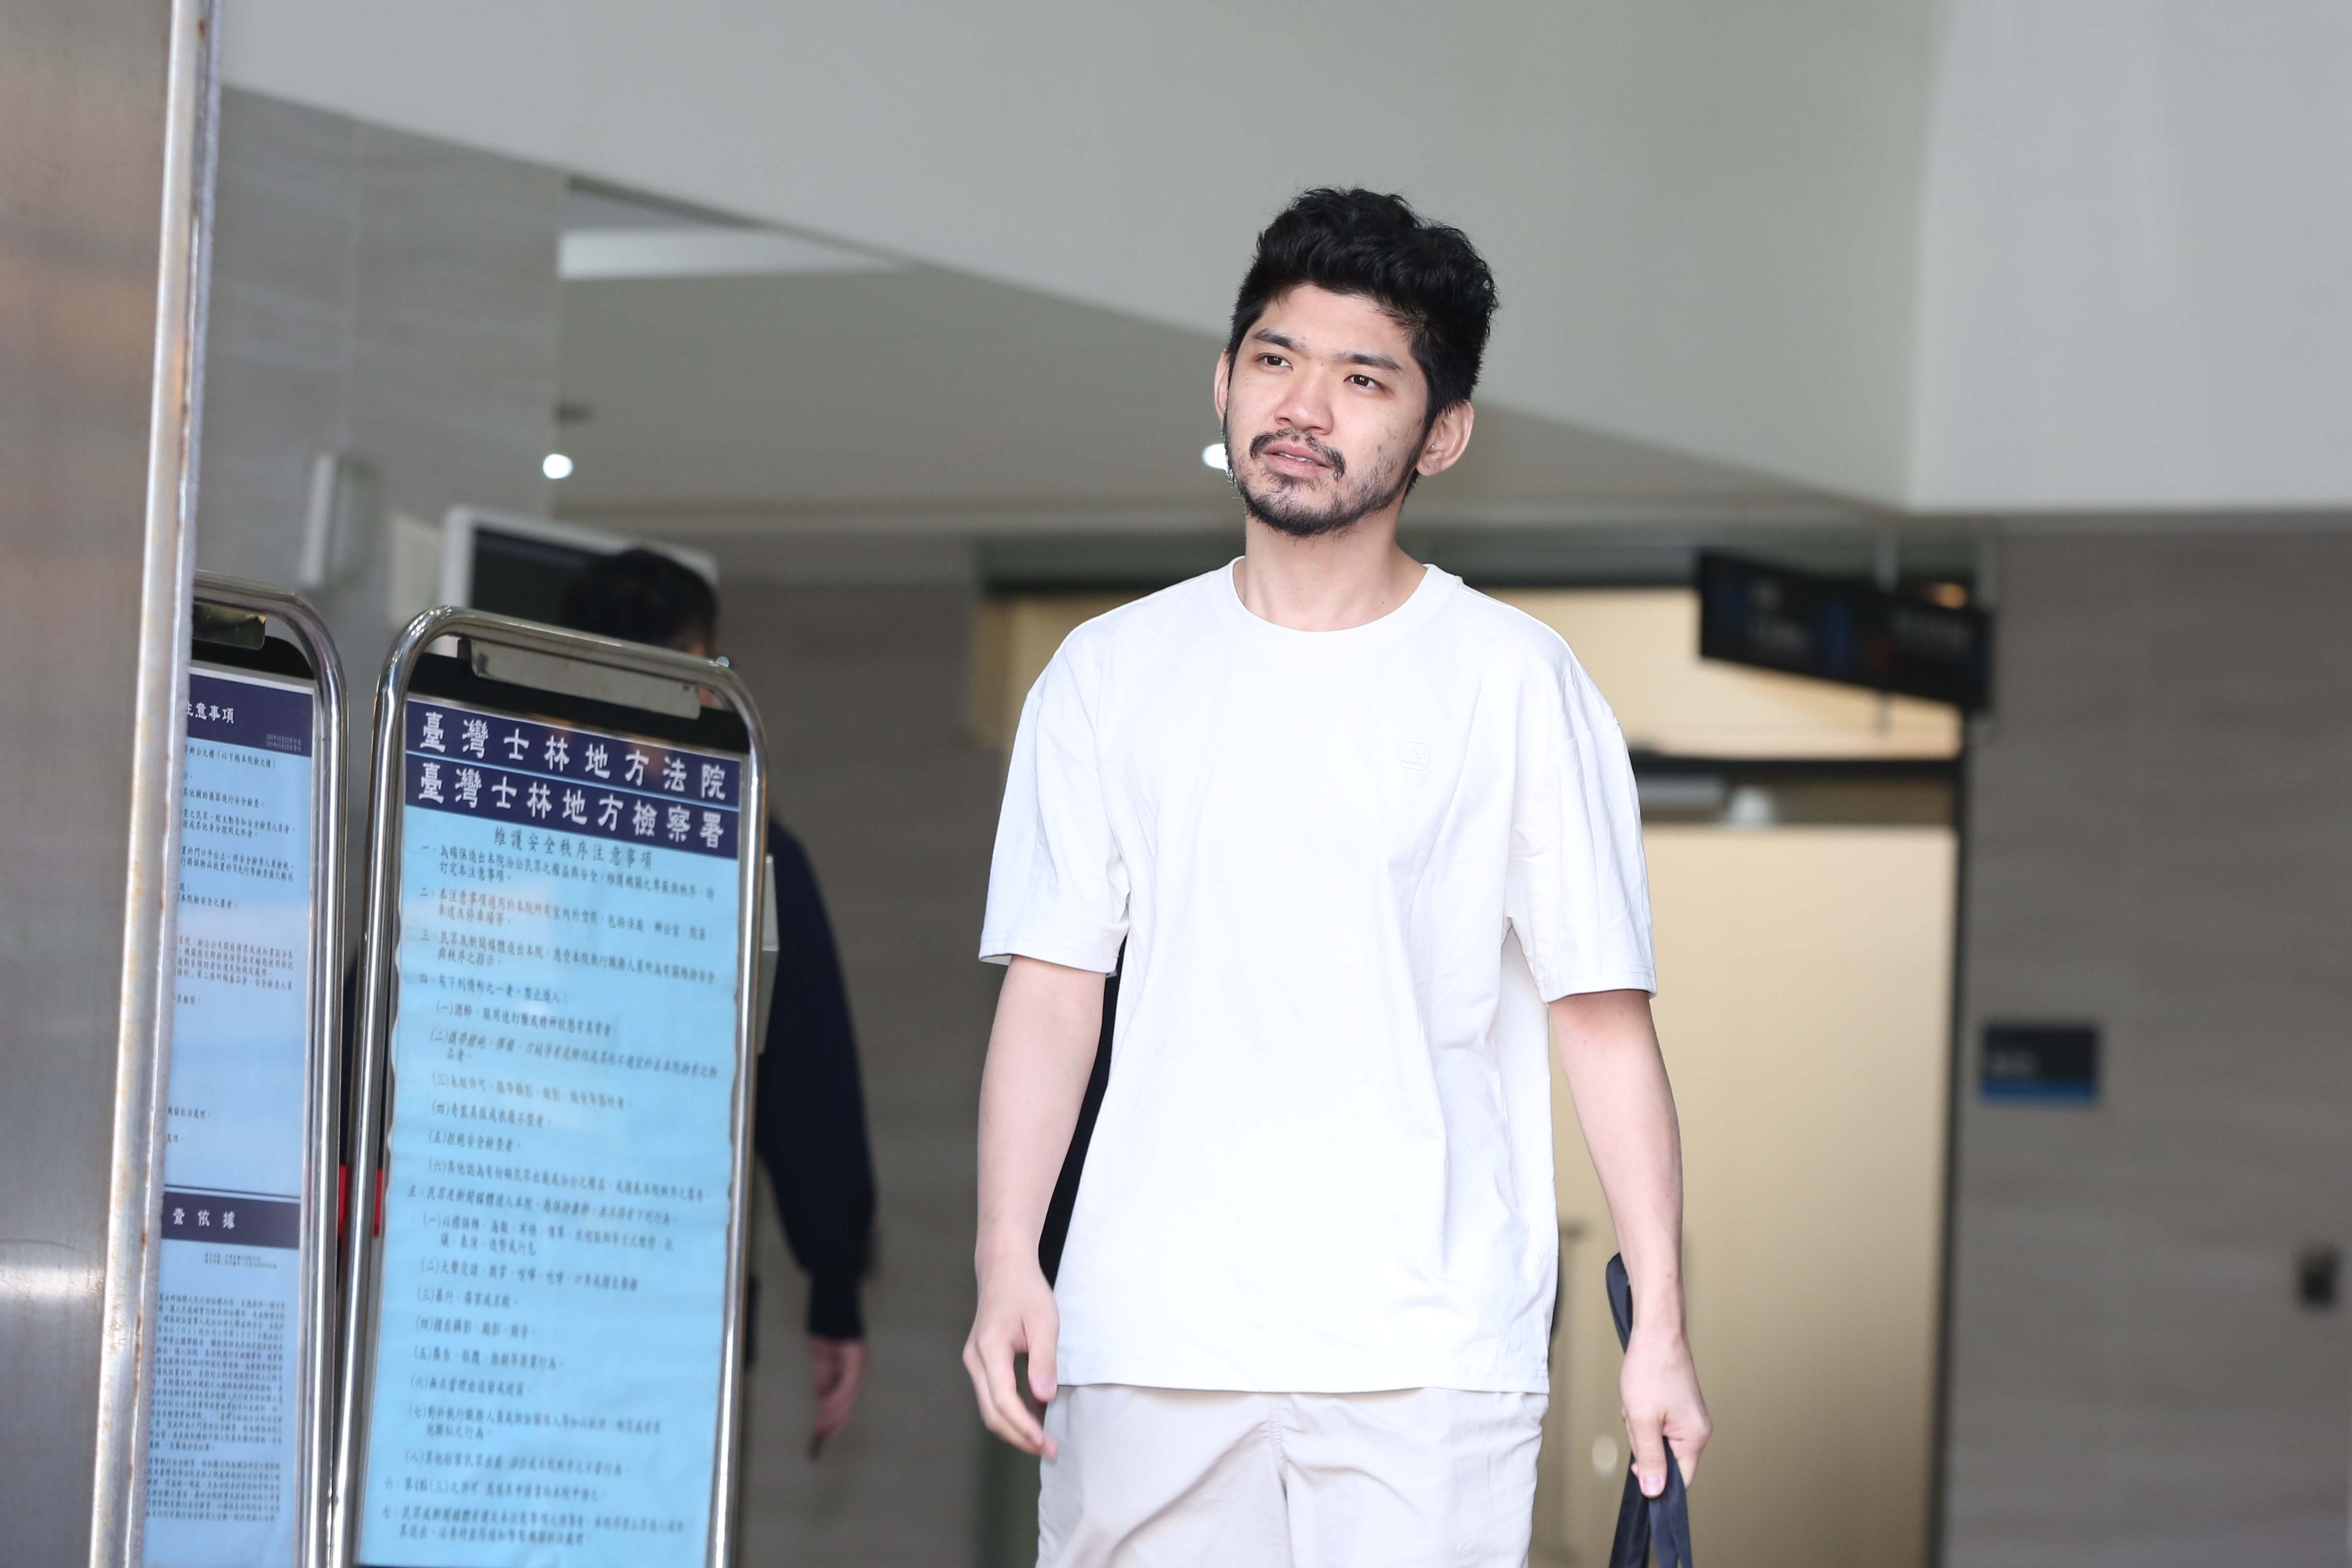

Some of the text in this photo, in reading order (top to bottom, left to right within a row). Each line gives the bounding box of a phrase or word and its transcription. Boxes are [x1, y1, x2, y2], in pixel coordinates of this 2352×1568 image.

[419, 711, 725, 799] 臺灣士林地方法院
[419, 762, 723, 847] 臺灣士林地方檢察署
[494, 828, 651, 869] 維護安全秩序注意事項
[173, 1208, 235, 1229] 查依據
